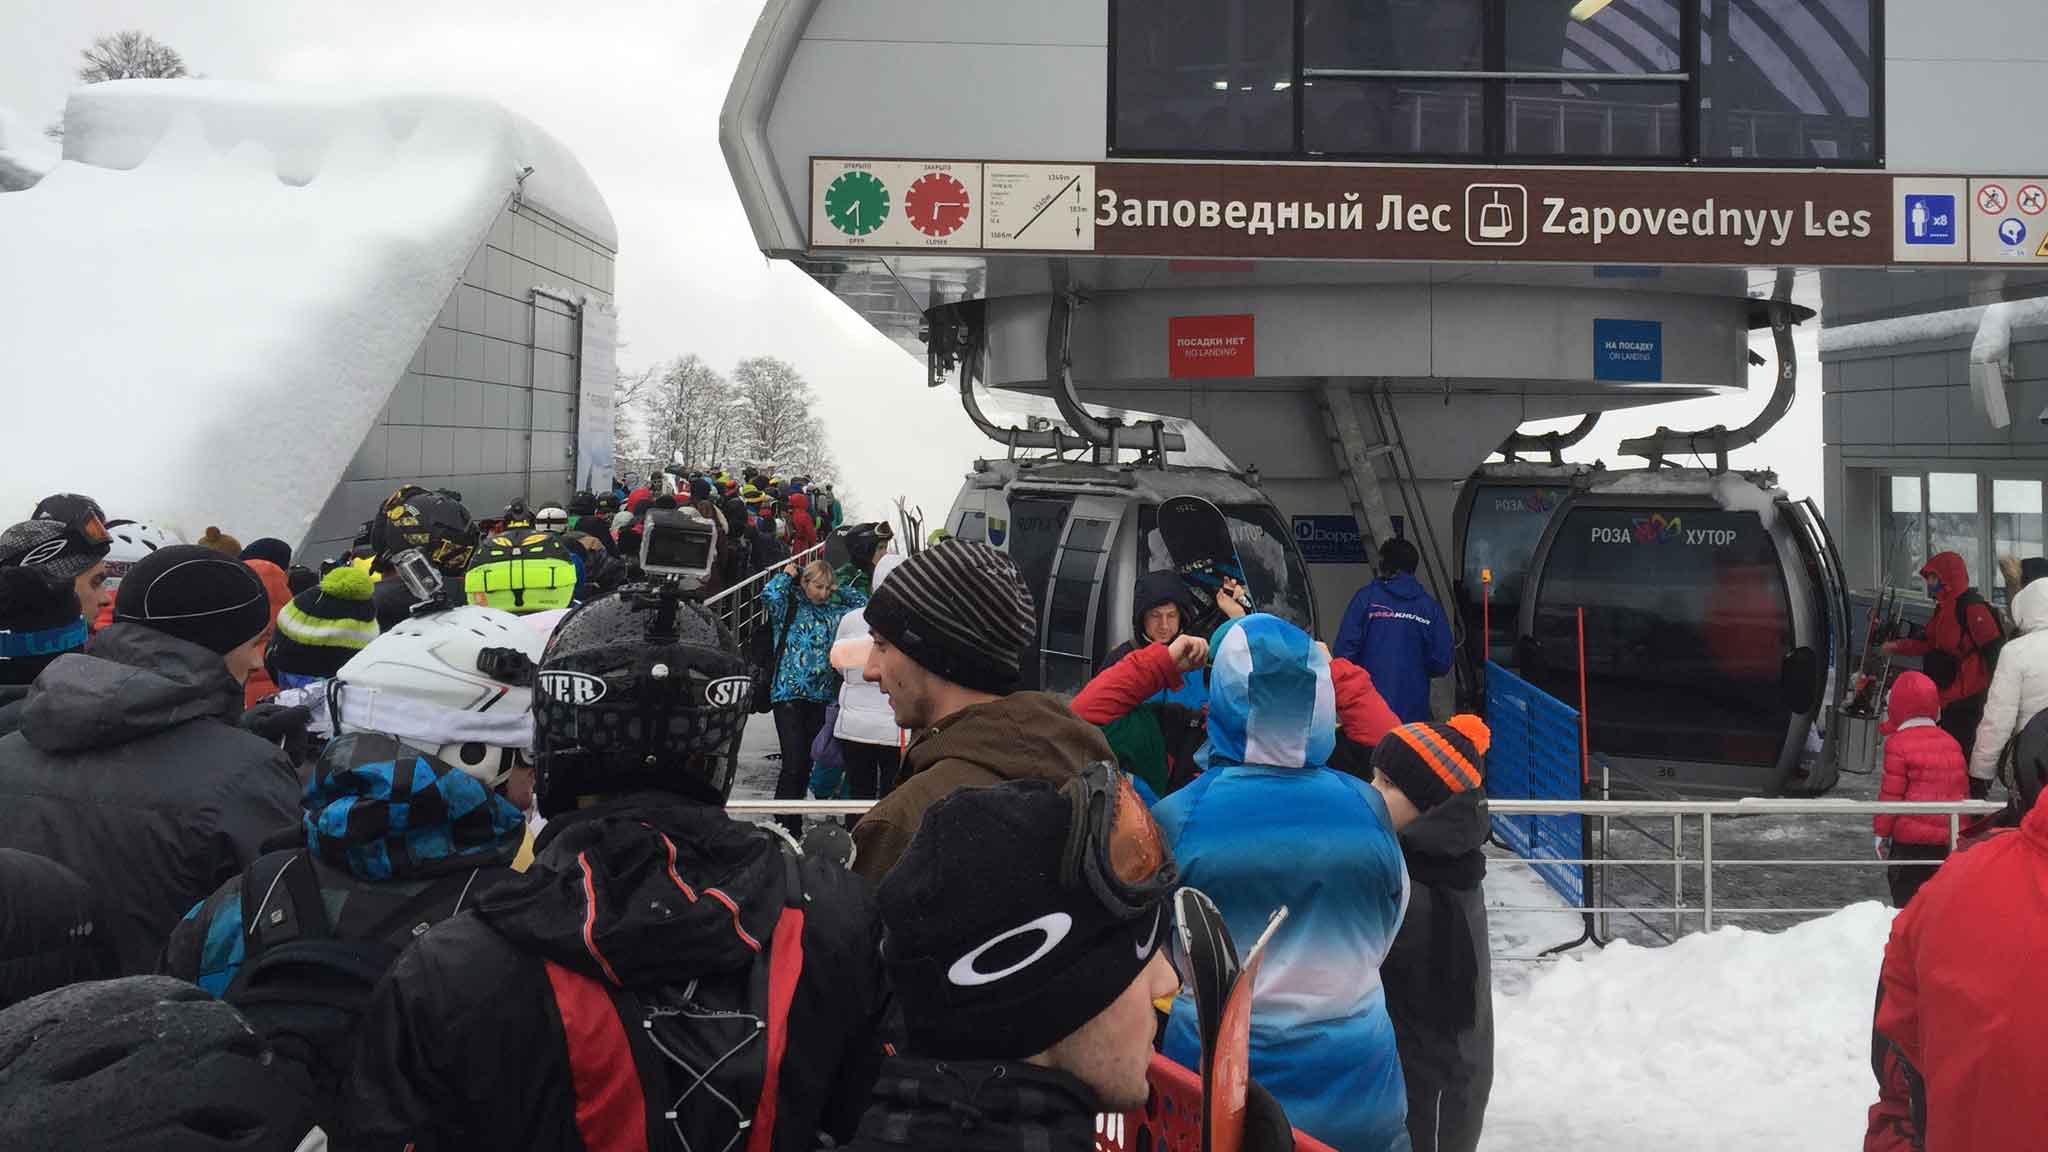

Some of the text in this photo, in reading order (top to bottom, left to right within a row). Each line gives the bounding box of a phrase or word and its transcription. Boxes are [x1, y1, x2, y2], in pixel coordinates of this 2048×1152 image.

[1095, 188, 1452, 235] Заповедный Лес
[1542, 197, 1871, 245] Zapovednyy Les
[1932, 214, 1948, 226] x8
[1177, 337, 1246, 347] ПОСАДКИ НЕТ
[1605, 341, 1653, 351] НА ПОСАДКУ
[1185, 348, 1238, 359] NO LANDING
[1591, 528, 1737, 545] РОЗА ХУТОР
